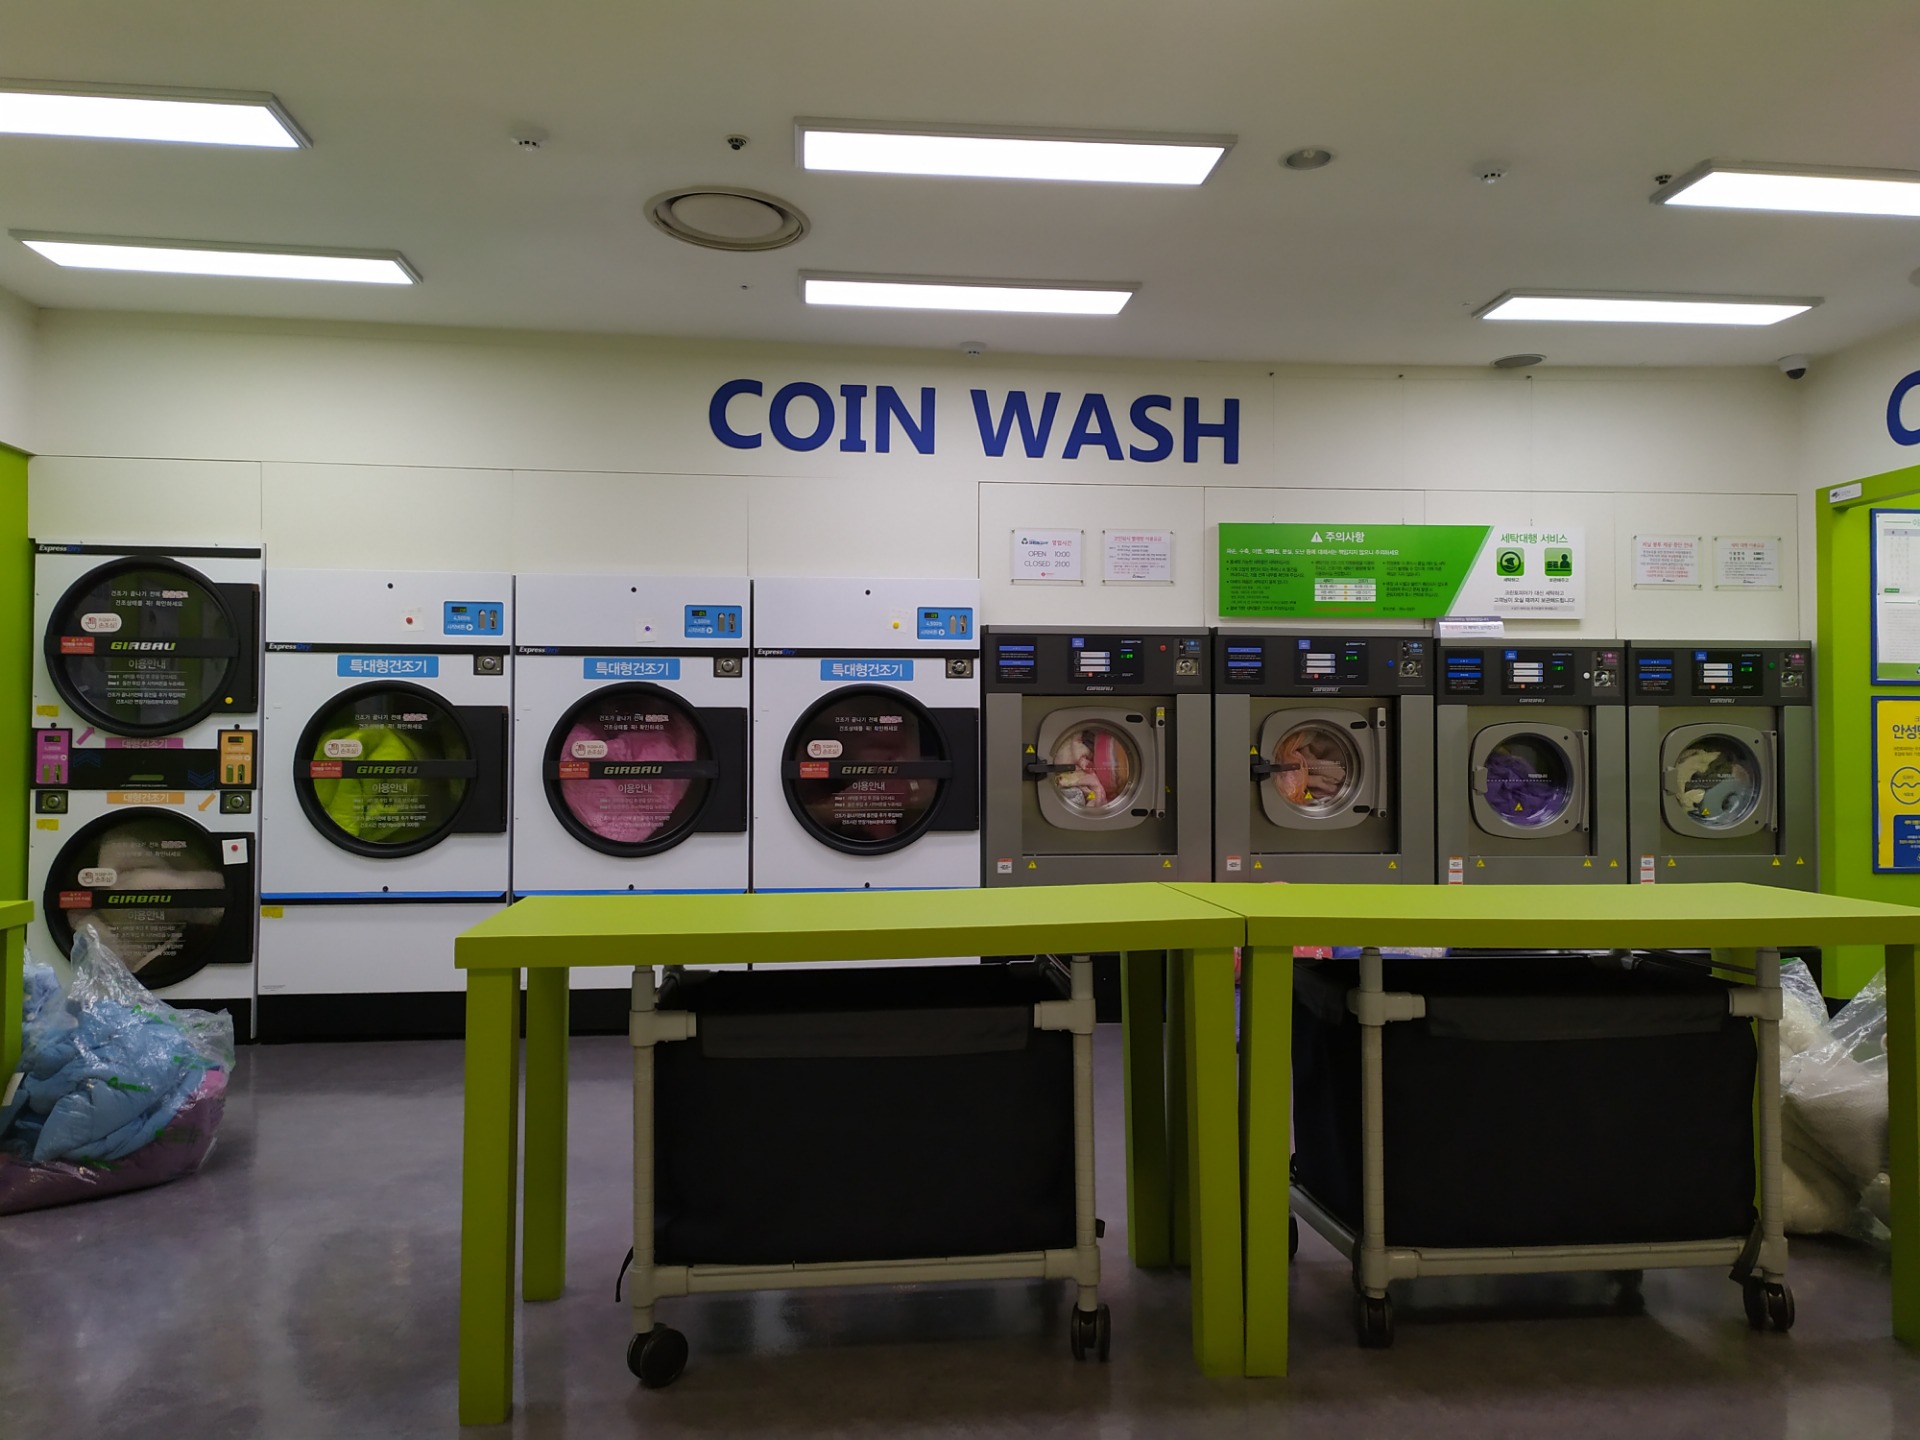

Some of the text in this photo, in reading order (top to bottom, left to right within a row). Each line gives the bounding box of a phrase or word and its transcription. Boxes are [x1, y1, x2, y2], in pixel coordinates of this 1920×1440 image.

[709, 378, 1240, 464] COIN WASH
[1325, 531, 1365, 543] 주의사항
[1500, 533, 1568, 544] 세탁대행 서비스
[110, 641, 176, 651] GIRBAU
[128, 658, 166, 670] 이용안내
[350, 659, 427, 674] 특대형건조기
[595, 661, 669, 676] 특대형건조기
[831, 663, 903, 677] 특대형건조기
[356, 765, 418, 774] GIRBAU
[603, 766, 663, 775] GIRBAU
[372, 783, 408, 794] 이용안내
[618, 783, 652, 794] 이용안내
[852, 781, 886, 791] 이용안내
[123, 793, 169, 803] 대형건조기
[108, 895, 172, 904] GIRBAU
[128, 910, 164, 921] 이용안내
